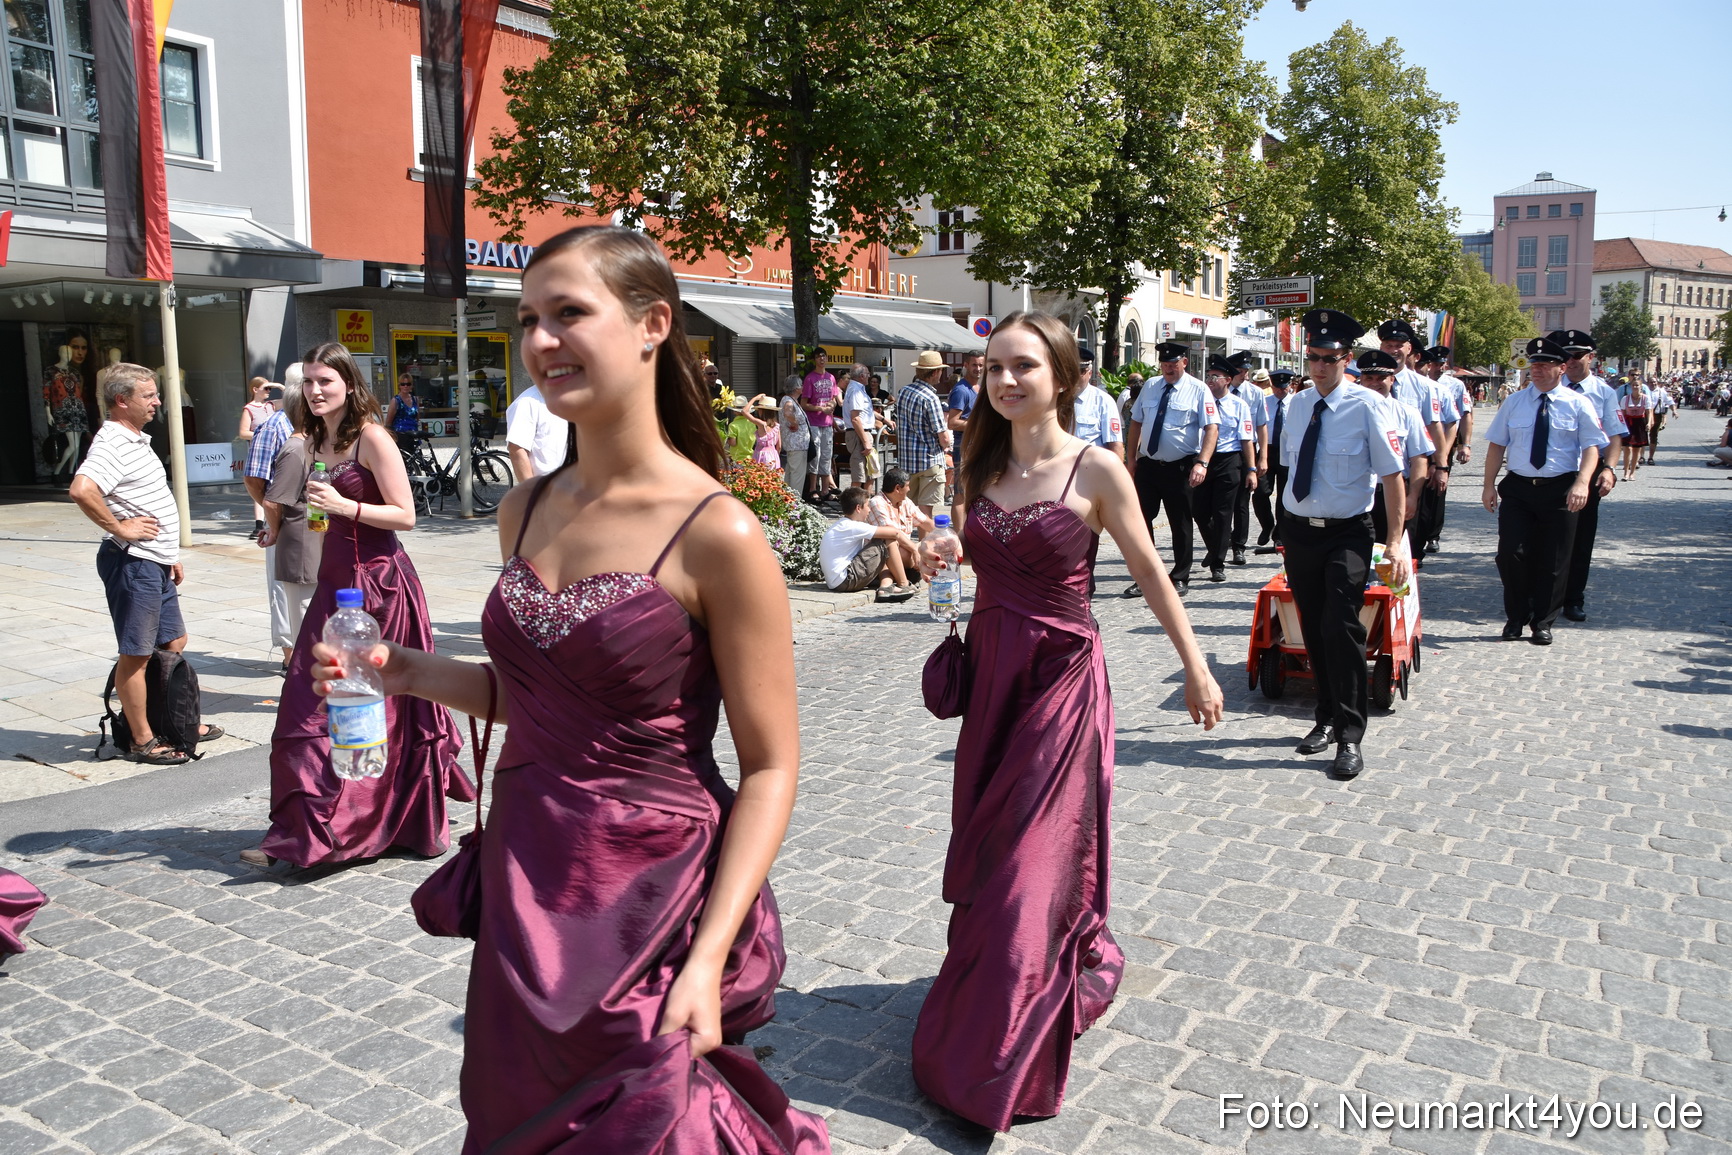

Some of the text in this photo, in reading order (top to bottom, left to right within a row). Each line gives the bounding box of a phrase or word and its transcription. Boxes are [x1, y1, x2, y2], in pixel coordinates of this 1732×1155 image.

[465, 239, 535, 269] BAKW
[765, 266, 918, 294] JUWE CHLIERF
[1252, 281, 1299, 291] Parkleitsystem
[1268, 295, 1300, 303] Rosengasse
[341, 333, 369, 343] LOTTO
[827, 355, 853, 363] HLIERF
[194, 453, 226, 462] SEASON
